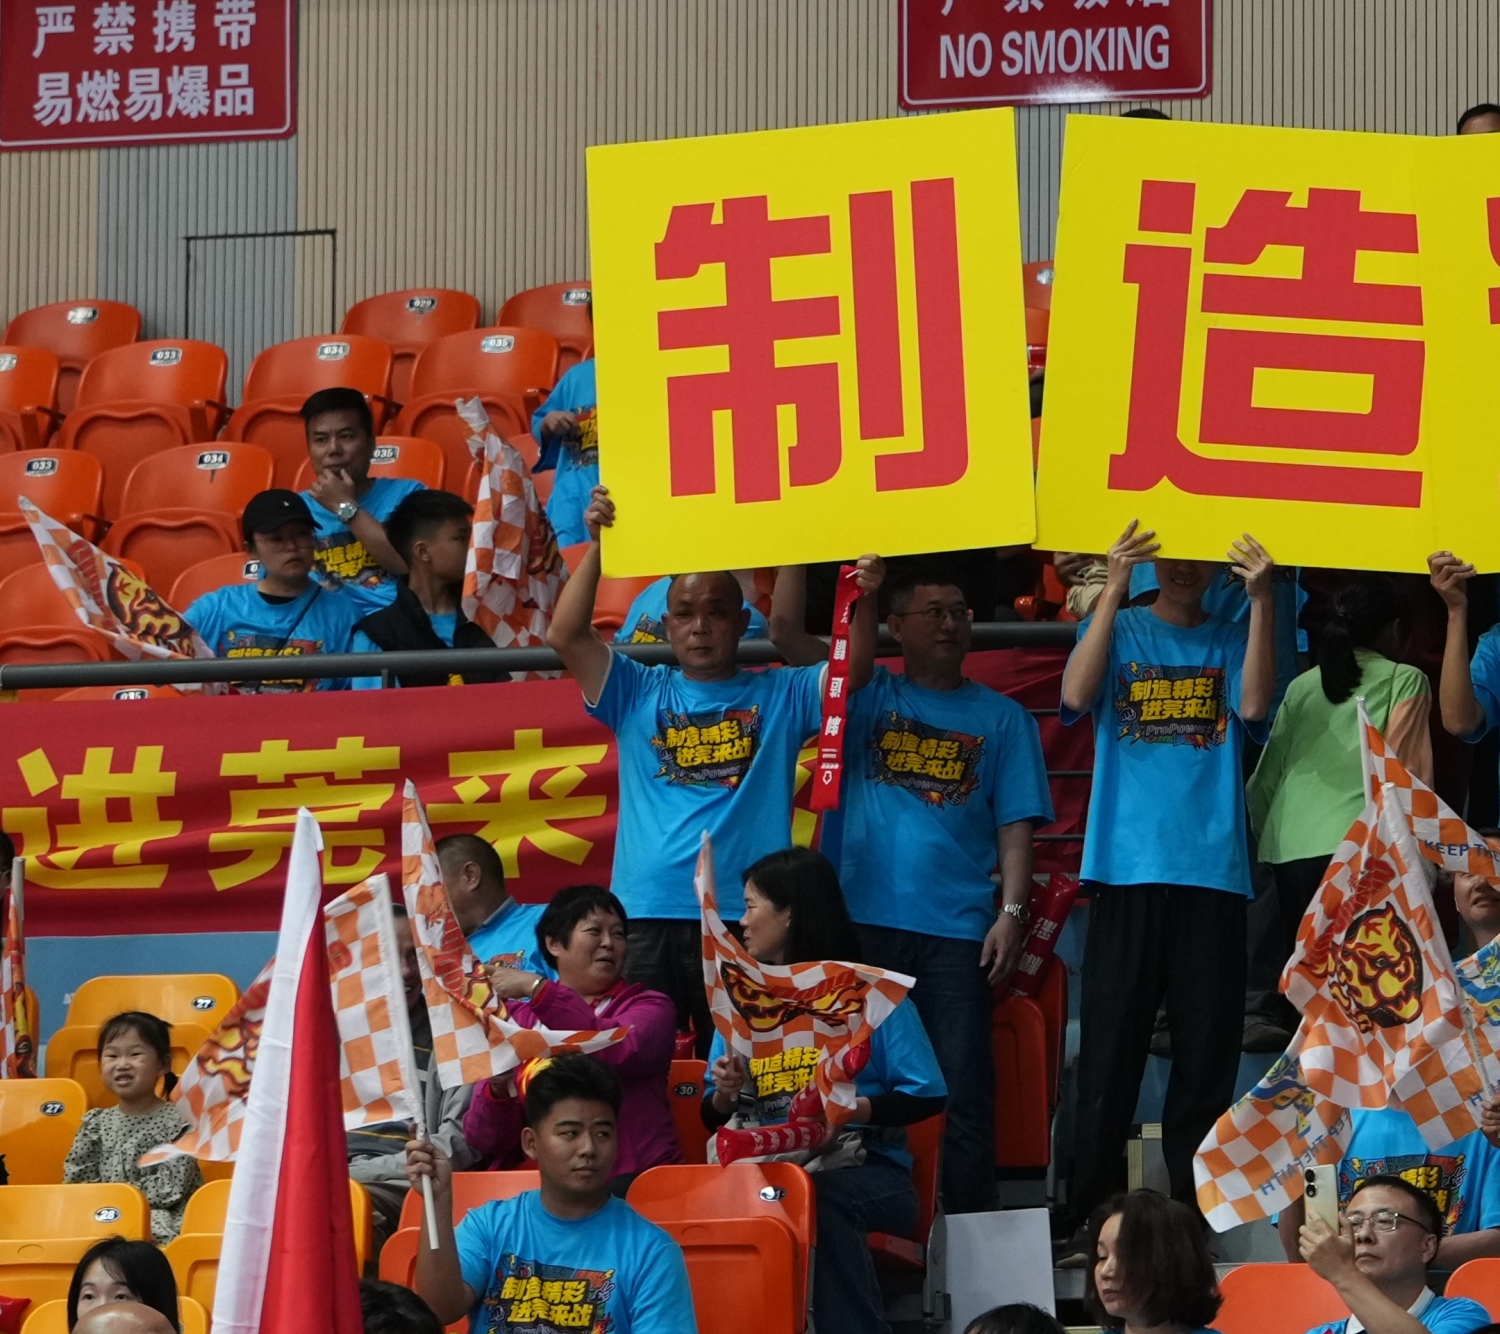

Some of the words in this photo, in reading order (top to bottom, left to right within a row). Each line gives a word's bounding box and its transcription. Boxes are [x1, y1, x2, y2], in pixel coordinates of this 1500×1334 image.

[938, 32, 994, 80] NO
[1000, 24, 1171, 77] SMOKING
[32, 61, 256, 128] 易燃易爆品
[1129, 676, 1214, 701] 制造精彩
[1139, 699, 1217, 722] 进莞来战
[666, 720, 739, 749] 制造精彩
[880, 730, 959, 758] 制造精彩
[676, 736, 751, 768] 进莞来战
[885, 753, 966, 781] 进莞来战
[196, 1000, 211, 1008] 27
[680, 1086, 693, 1094] 30
[100, 1211, 115, 1219] 28
[507, 1299, 595, 1327] 进莞来战
